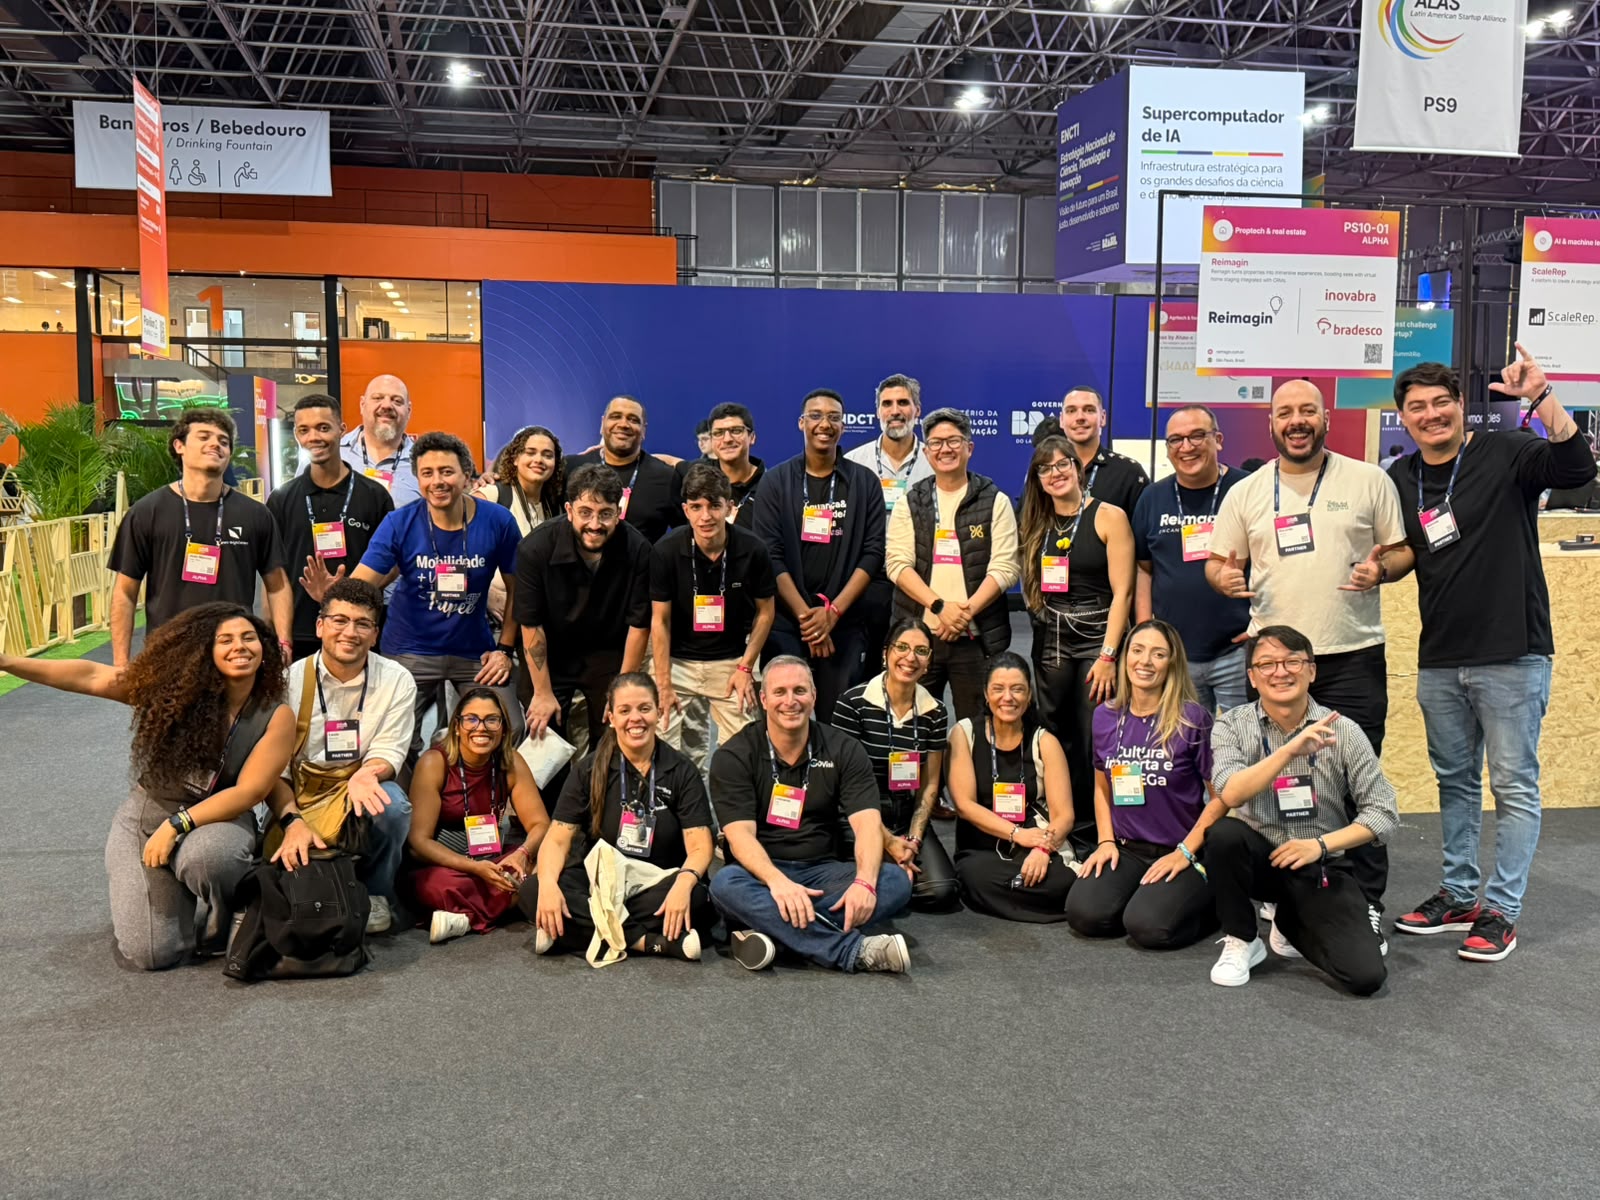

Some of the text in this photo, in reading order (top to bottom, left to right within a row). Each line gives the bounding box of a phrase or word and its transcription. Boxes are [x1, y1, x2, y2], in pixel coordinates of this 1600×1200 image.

[1427, 12, 1457, 20] American
[1459, 13, 1482, 21] Startup
[1483, 15, 1507, 23] Alliance
[1424, 96, 1458, 113] PS9
[1142, 105, 1285, 126] Supercomputador
[100, 114, 189, 134] Banros
[210, 119, 307, 137] Bebedouro
[1060, 122, 1080, 145] ENCTI
[1141, 128, 1181, 143] de IA
[176, 138, 222, 152] Drinking
[226, 140, 273, 152] Fountain
[1060, 129, 1116, 165] Estratégia Nacional de
[1079, 149, 1107, 170] Tecnologia
[1107, 148, 1111, 158] e
[1140, 161, 1283, 175] Infraestrutura estratégica para
[1060, 173, 1081, 191] Inovação
[1140, 175, 1284, 188] os grandes desafios da ciência
[1140, 191, 1146, 199] e
[1088, 196, 1098, 208] para
[1100, 201, 1120, 216] soberano
[1235, 226, 1307, 236] Proptech & real estate
[1343, 222, 1389, 235] PS10-01
[1362, 236, 1389, 246] ALPHA
[1568, 238, 1592, 246] machine
[1211, 258, 1249, 268] Reimagin
[1532, 267, 1567, 277] ScaleRep
[1325, 289, 1377, 302] inovabra
[197, 285, 224, 332] 1
[1208, 311, 1273, 327] Reimagin
[1394, 320, 1437, 331] est challenge
[1333, 323, 1383, 336] bradesco
[1394, 330, 1413, 339] rtup?
[1031, 401, 1064, 409] GOVERN
[987, 409, 998, 417] DA
[970, 427, 998, 436] VAÇÃO
[416, 554, 485, 570] Mobilidade
[1163, 761, 1174, 772] e
